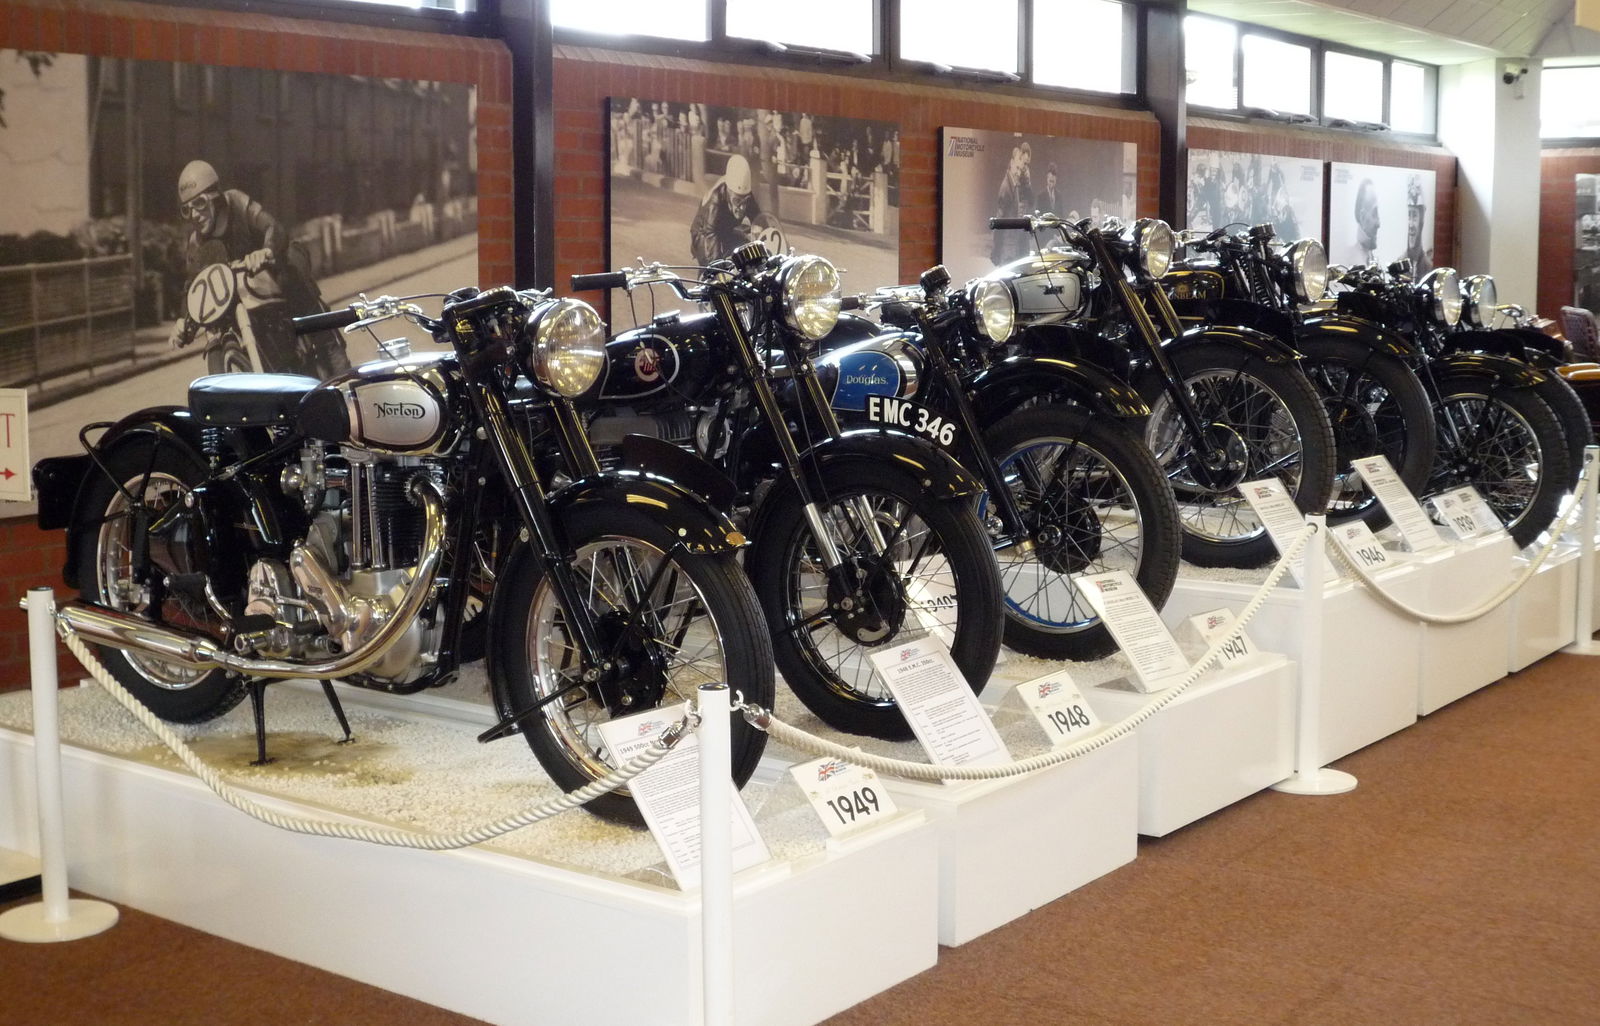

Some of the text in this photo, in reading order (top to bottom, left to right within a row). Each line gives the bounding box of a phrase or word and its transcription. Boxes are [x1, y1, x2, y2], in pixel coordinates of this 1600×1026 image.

[192, 265, 230, 322] 20
[373, 402, 426, 420] Norton
[869, 396, 957, 446] EMC 346
[1356, 546, 1386, 566] 1946
[1221, 635, 1248, 661] 1947
[1047, 705, 1090, 735] 1948
[826, 786, 880, 825] 1949
